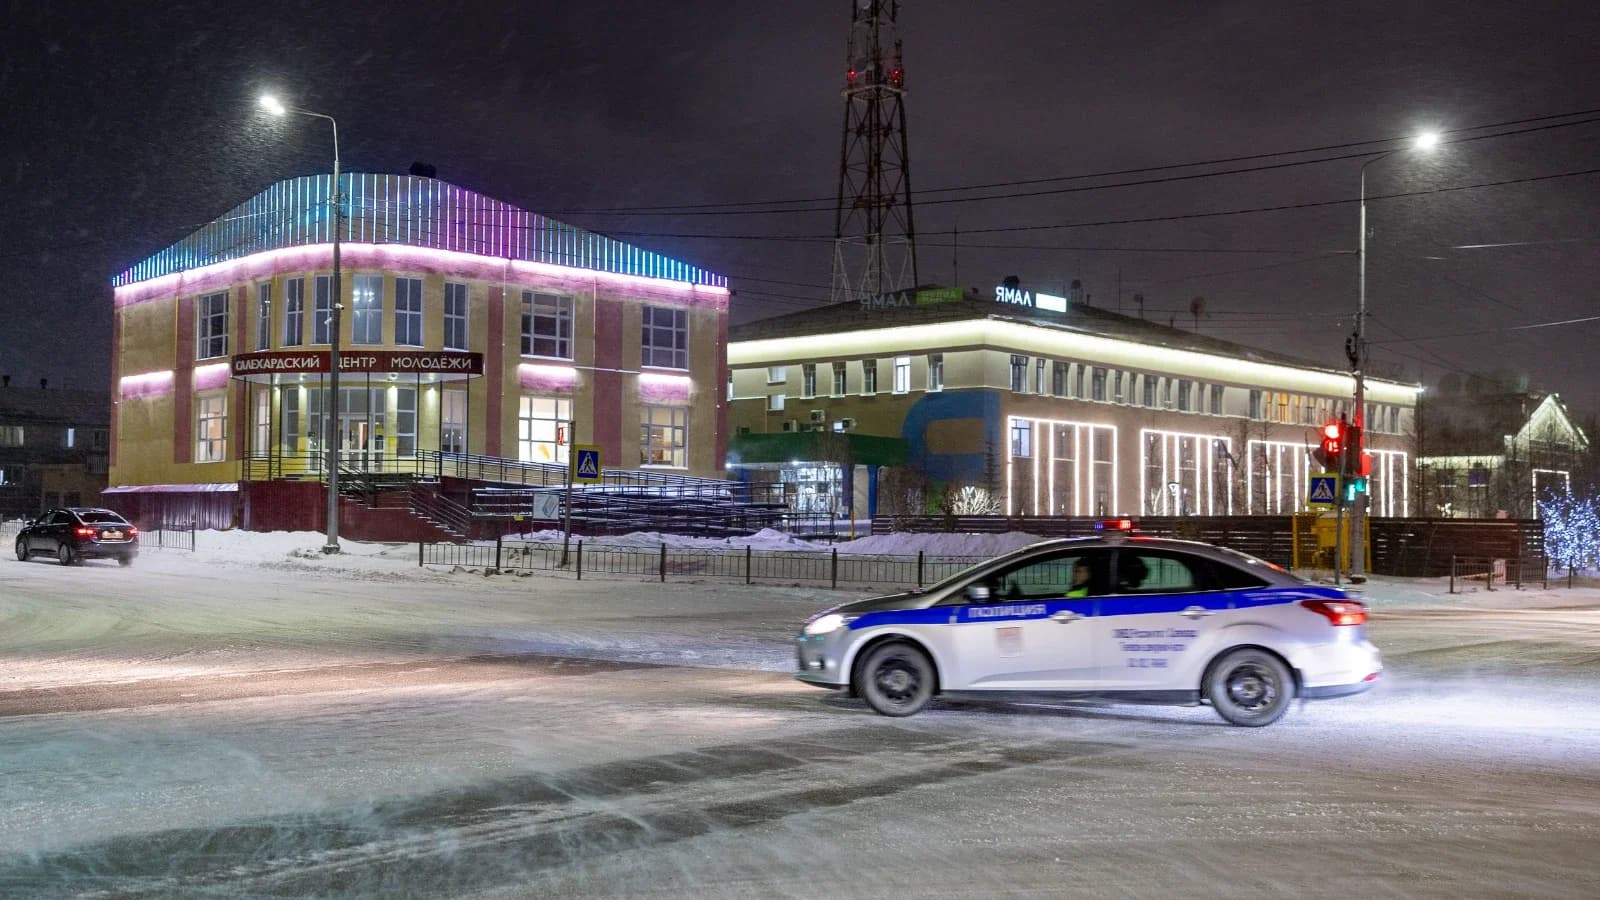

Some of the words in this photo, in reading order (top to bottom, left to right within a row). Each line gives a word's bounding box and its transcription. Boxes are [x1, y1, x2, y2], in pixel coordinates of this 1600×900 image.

[995, 285, 1032, 307] ЯМАЛ
[235, 355, 320, 371] САЛЕХАРДСКИЙ
[391, 355, 472, 369] МОЛОДЁЖИ
[968, 604, 1047, 618] ПОЛИЦИЯ
